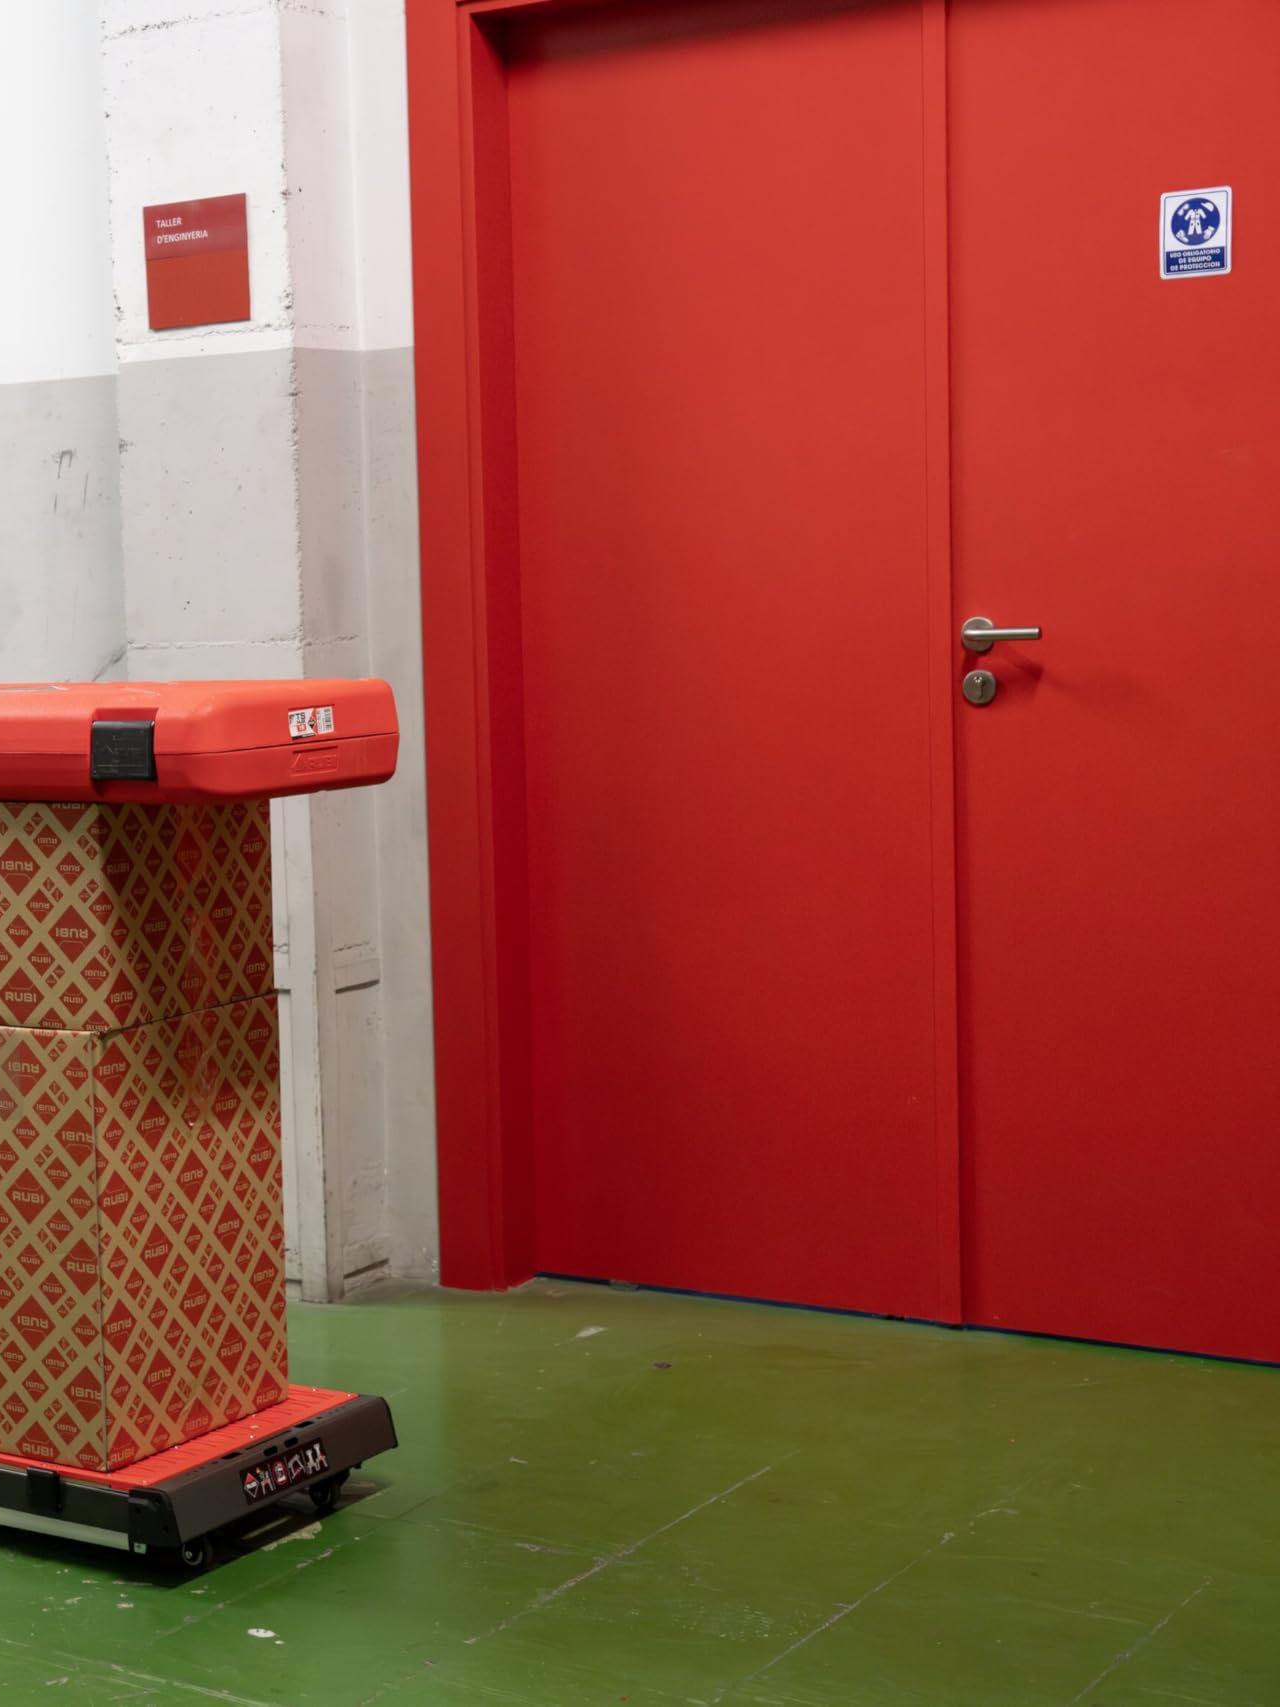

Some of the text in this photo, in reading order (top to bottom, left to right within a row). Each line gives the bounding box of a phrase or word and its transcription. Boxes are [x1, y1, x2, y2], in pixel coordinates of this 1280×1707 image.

[156, 217, 182, 228] TALLER
[157, 230, 208, 244] D'ENGINYERIA
[1183, 248, 1220, 257] OBLIGATORIO
[243, 841, 263, 853] RUBI
[0, 861, 33, 871] RUBI
[56, 928, 88, 938] RUBI
[246, 962, 265, 974] RUBI
[5, 992, 37, 1003] RUBI
[110, 990, 133, 1003] RUBI
[9, 1062, 40, 1073] RUBI
[100, 1062, 127, 1075] RUBI
[216, 1099, 236, 1112] RUBI
[142, 1116, 165, 1130] RUBI
[251, 1150, 272, 1163] RUBI
[181, 1168, 203, 1182] RUBI
[12, 1192, 44, 1203] RUBI
[103, 1192, 128, 1207] RUBI
[219, 1219, 240, 1232] RUBI
[144, 1244, 168, 1259] RUBI
[254, 1268, 274, 1282] RUBI
[184, 1295, 206, 1309] RUBI
[17, 1316, 48, 1328] RUBI
[107, 1318, 132, 1334] RUBI
[221, 1342, 242, 1357] RUBI
[148, 1368, 171, 1382] RUBI
[257, 1391, 278, 1404] RUBI
[186, 1416, 208, 1431] RUBI
[23, 1443, 53, 1456] RUBI
[111, 1447, 134, 1463] RUBI
